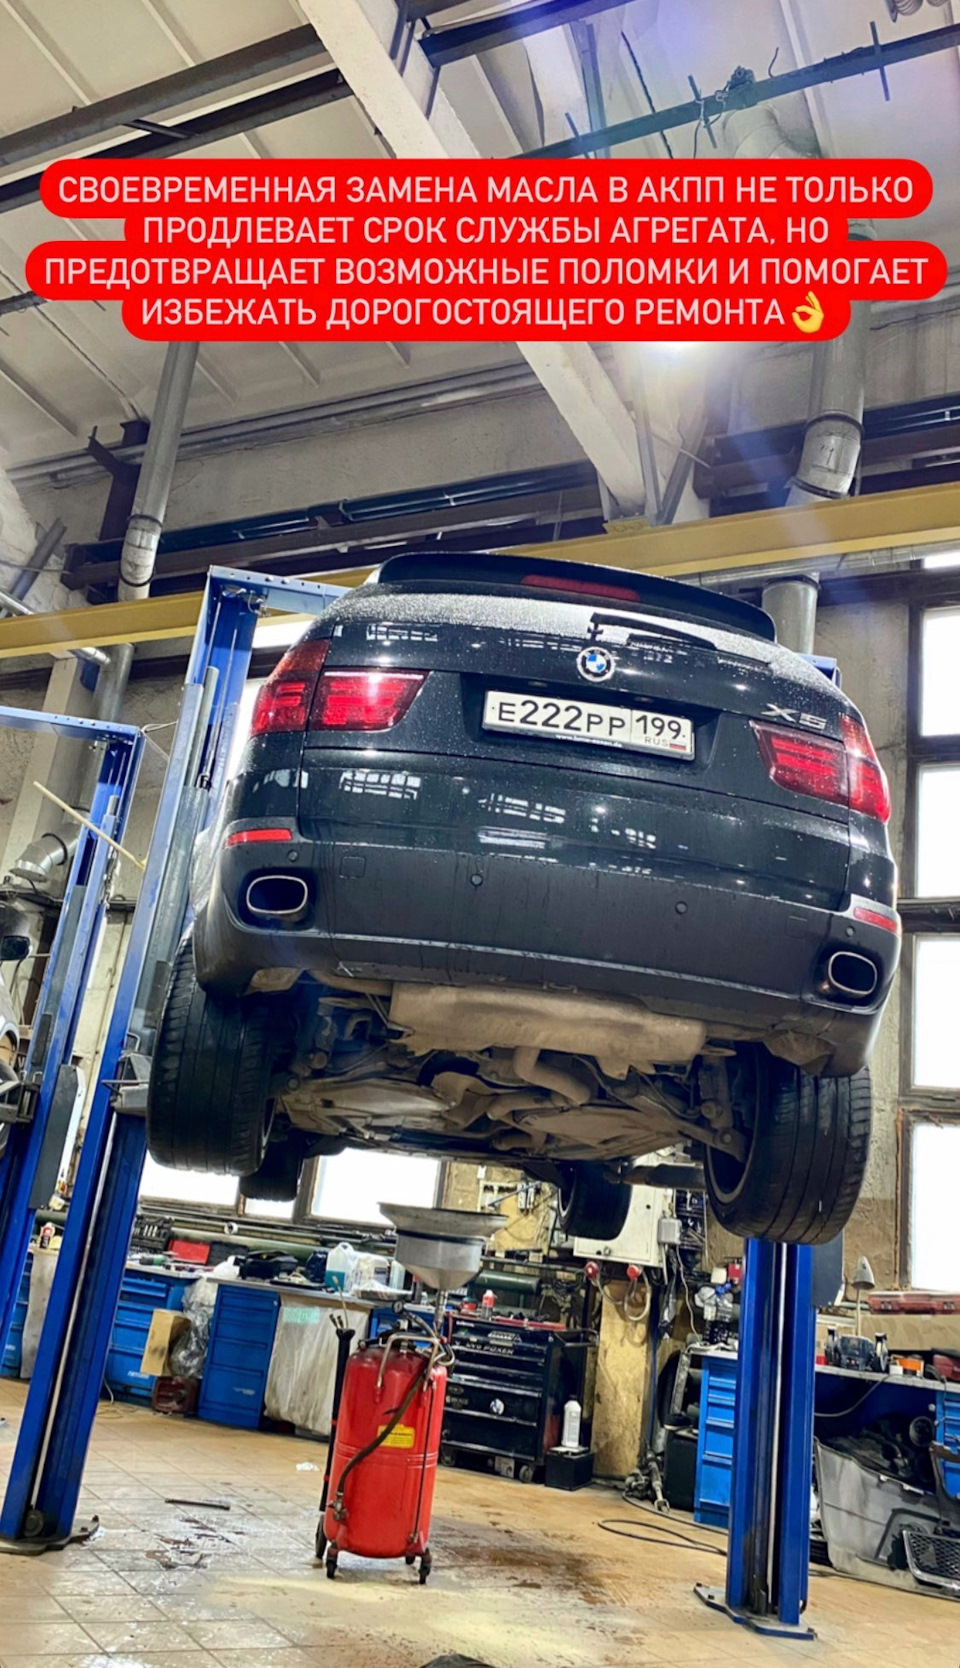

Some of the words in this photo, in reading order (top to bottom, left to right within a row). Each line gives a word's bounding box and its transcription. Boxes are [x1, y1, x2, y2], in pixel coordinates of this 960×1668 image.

[635, 714, 682, 740] 199
[761, 703, 827, 730] X5
[644, 736, 669, 748] RUS
